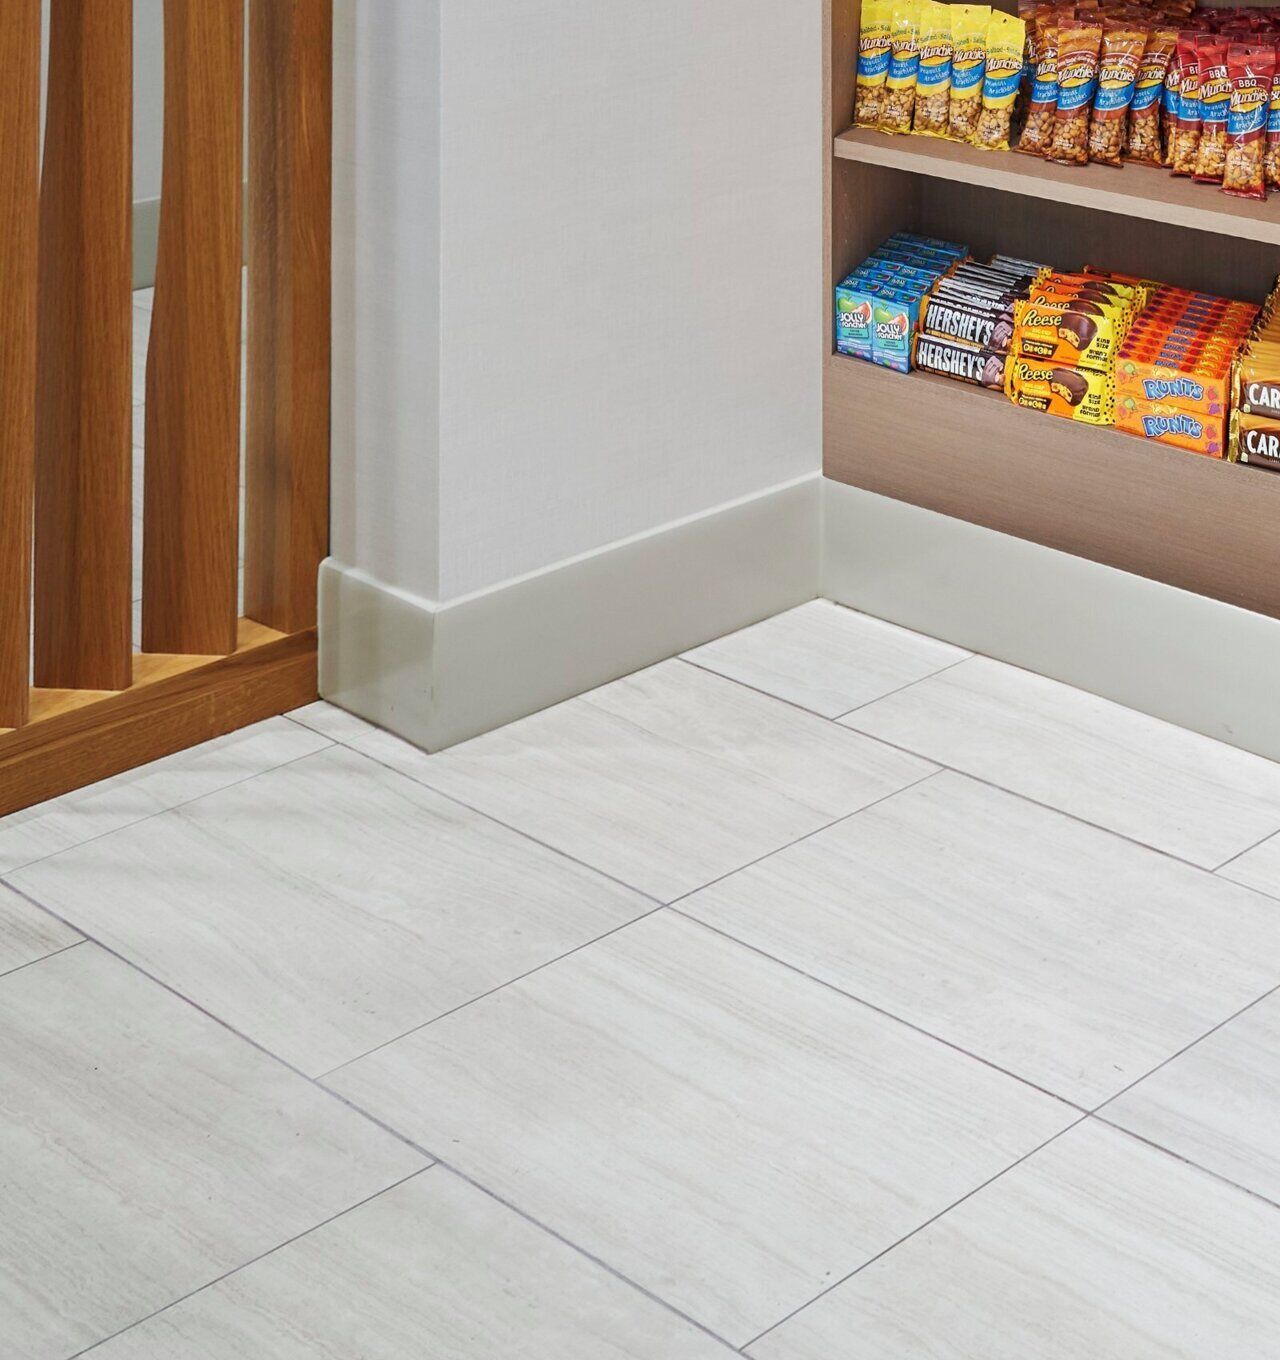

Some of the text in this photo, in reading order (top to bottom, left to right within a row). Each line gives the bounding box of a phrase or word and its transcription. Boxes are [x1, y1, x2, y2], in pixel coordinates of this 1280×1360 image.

[987, 58, 1022, 71] Munchies
[1238, 79, 1257, 88] BBQ
[840, 313, 864, 323] JOLLY
[926, 304, 995, 346] HERSHEY'S
[1022, 309, 1062, 327] Reese
[876, 323, 900, 334] JOLLY
[918, 341, 986, 382] HERSHEY'S
[1019, 364, 1053, 381] Reese
[1142, 378, 1203, 401] RUNTS
[1142, 414, 1203, 439] RUNTS
